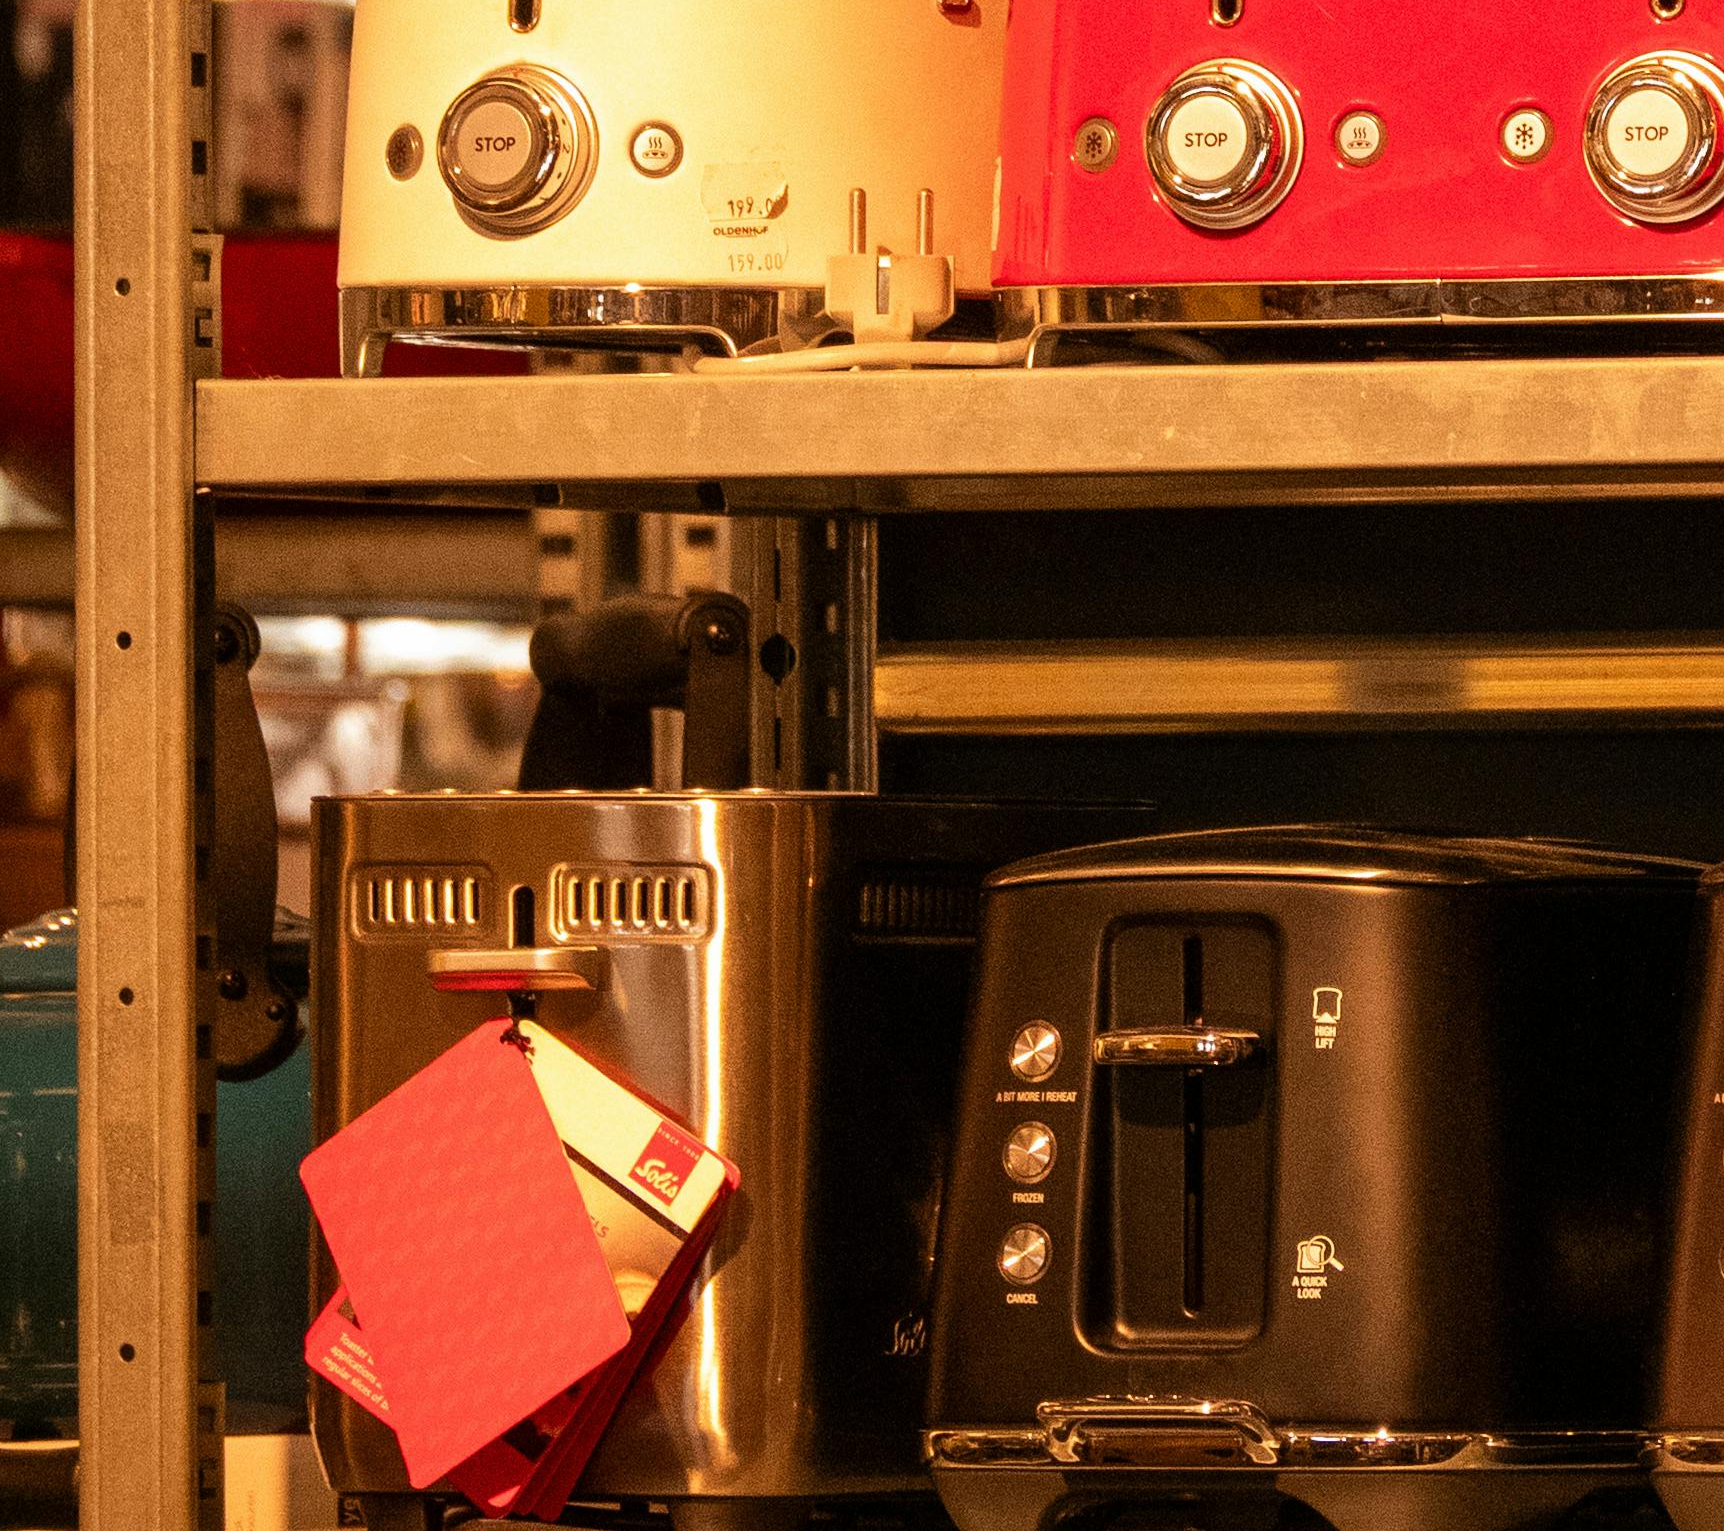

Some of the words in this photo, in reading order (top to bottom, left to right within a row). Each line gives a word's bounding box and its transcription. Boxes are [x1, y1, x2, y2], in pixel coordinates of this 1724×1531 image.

[1184, 131, 1228, 148] STOP
[1624, 125, 1669, 142] STOP
[474, 136, 516, 152] STOP
[728, 196, 774, 218] 199.0
[728, 252, 783, 272] 159.00
[1315, 1025, 1337, 1037] HIGH
[1315, 1037, 1335, 1049] LIFT
[1017, 1091, 1040, 1102] MORE
[1046, 1091, 1077, 1102] REHEAT
[634, 1158, 680, 1199] Solis
[1013, 1192, 1044, 1204] FROZEN
[1291, 1275, 1300, 1287] A
[1300, 1275, 1328, 1287] QUICK
[1006, 1293, 1038, 1305] CANCEL
[1297, 1287, 1322, 1299] LOOK
